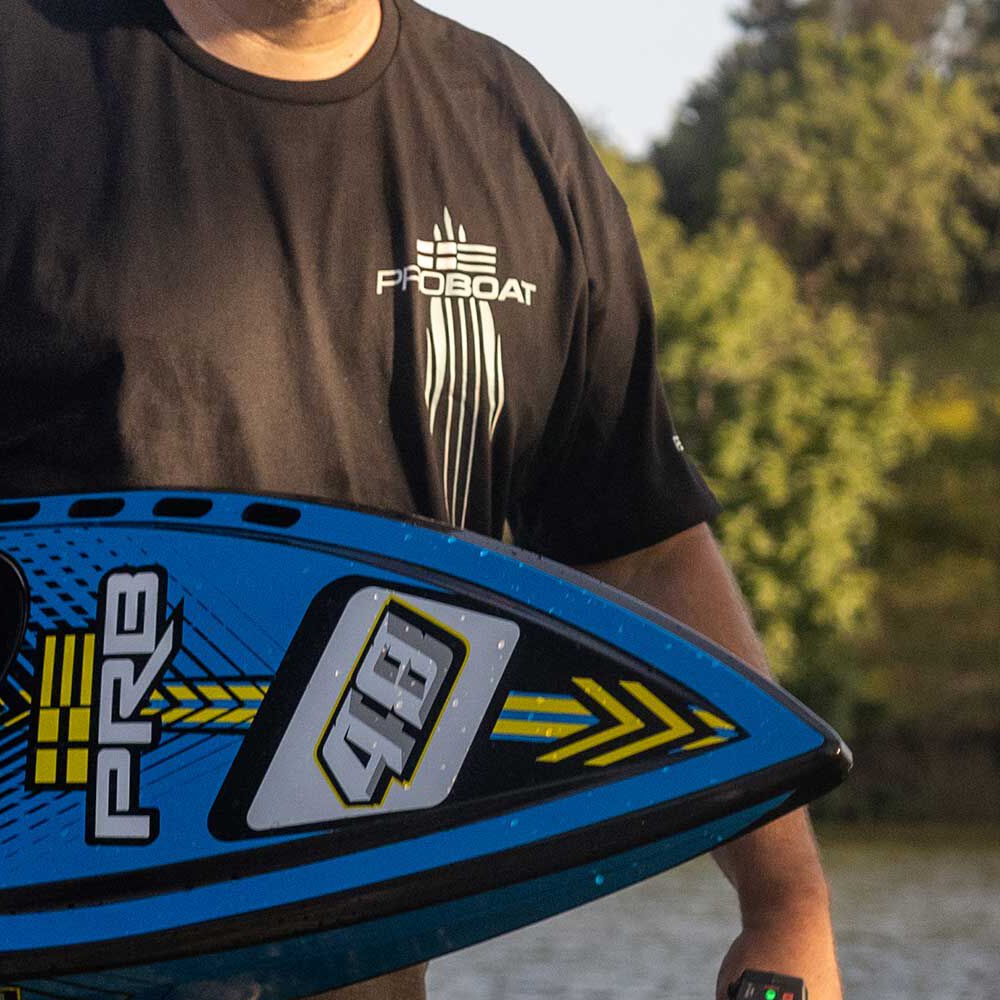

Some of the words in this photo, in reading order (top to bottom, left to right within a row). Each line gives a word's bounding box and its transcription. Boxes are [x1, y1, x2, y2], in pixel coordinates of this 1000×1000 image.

[376, 264, 537, 306] PROBOAT
[95, 571, 174, 839] PRB
[322, 611, 454, 803] 48
